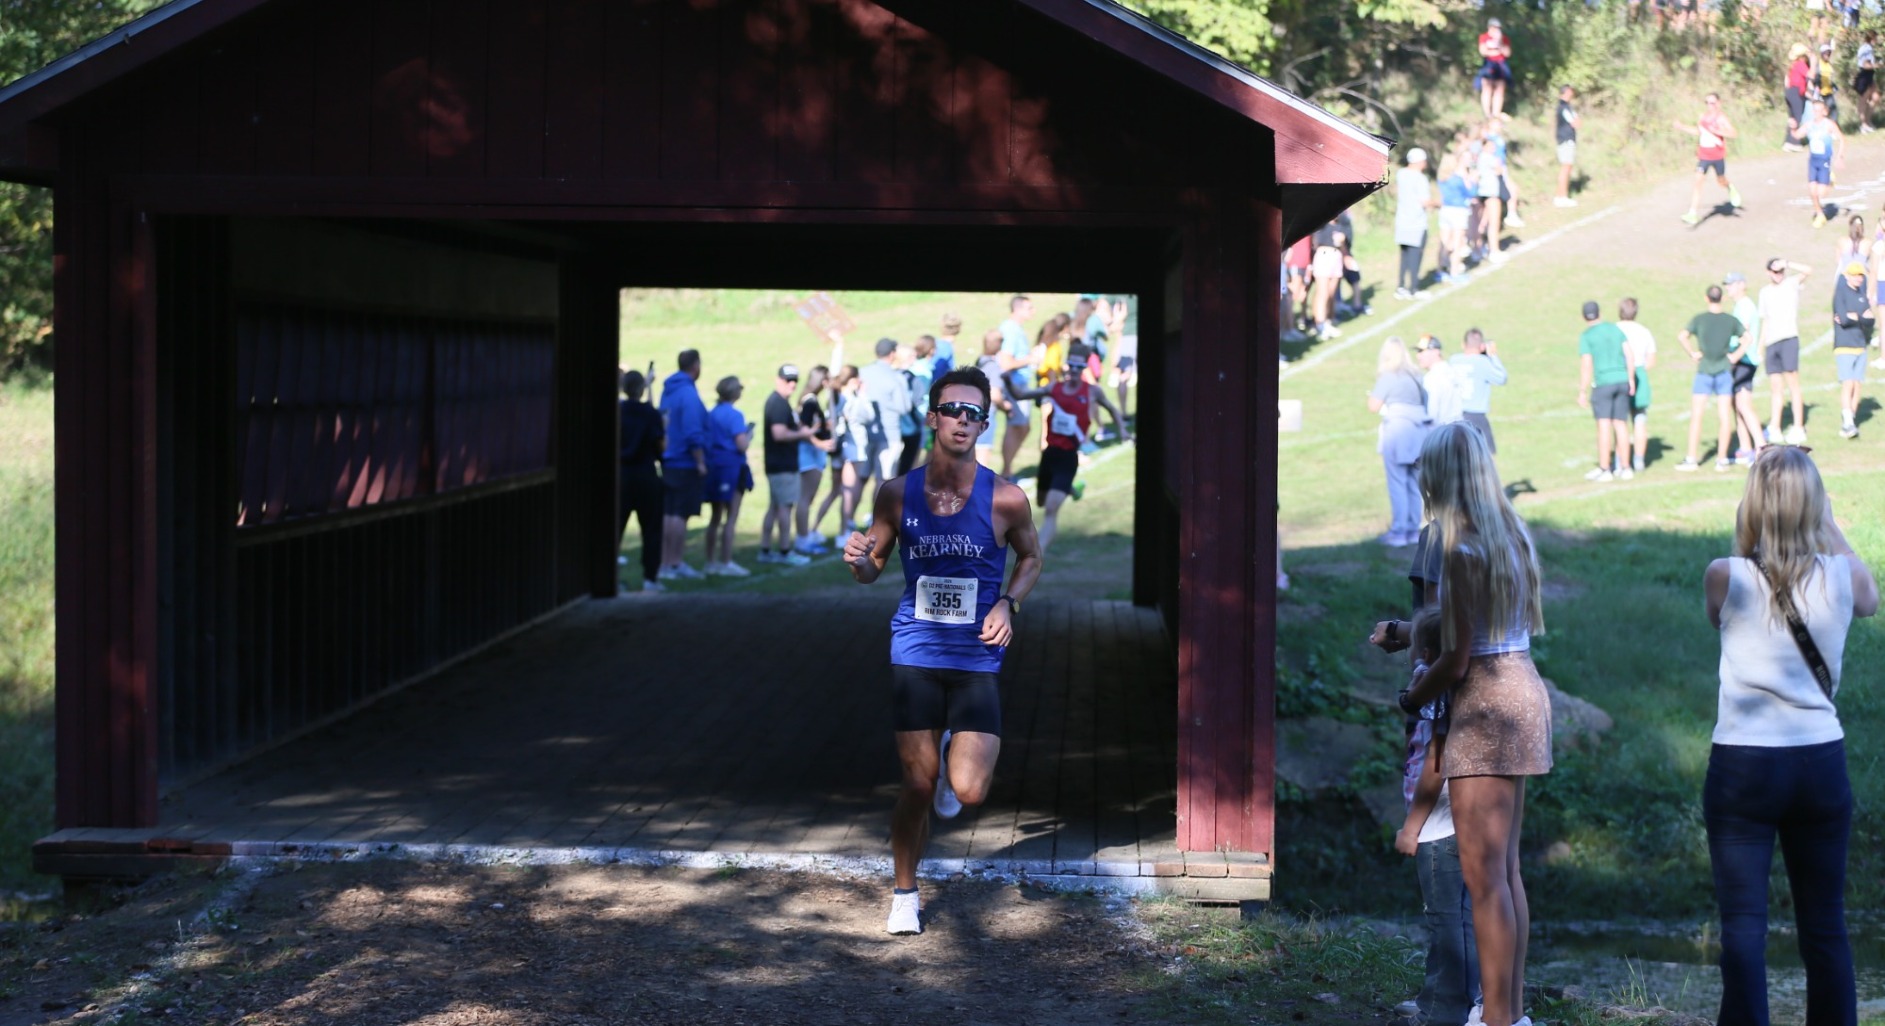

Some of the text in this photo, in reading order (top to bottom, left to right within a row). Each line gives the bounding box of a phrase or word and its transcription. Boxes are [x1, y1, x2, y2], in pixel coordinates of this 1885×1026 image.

[920, 534, 971, 544] NEBRASKA
[909, 543, 984, 560] KEARNEY
[932, 592, 962, 609] 355
